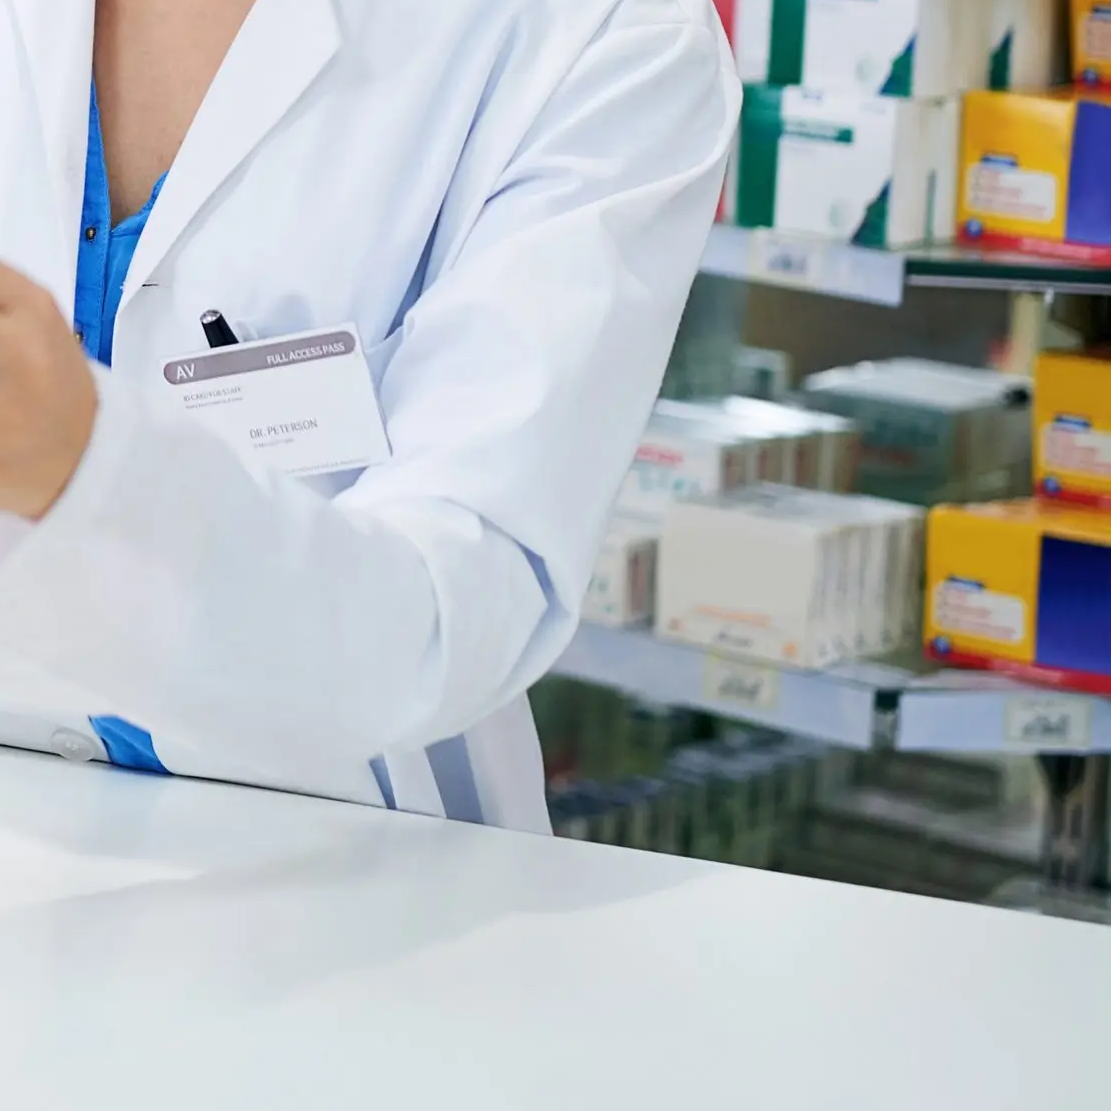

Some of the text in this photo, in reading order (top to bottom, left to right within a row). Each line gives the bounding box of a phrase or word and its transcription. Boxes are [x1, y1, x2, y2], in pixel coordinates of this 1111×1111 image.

[267, 342, 346, 365] FULL ACCESS PASS
[176, 363, 196, 380] AV
[249, 419, 319, 439] DR. PETERSON
